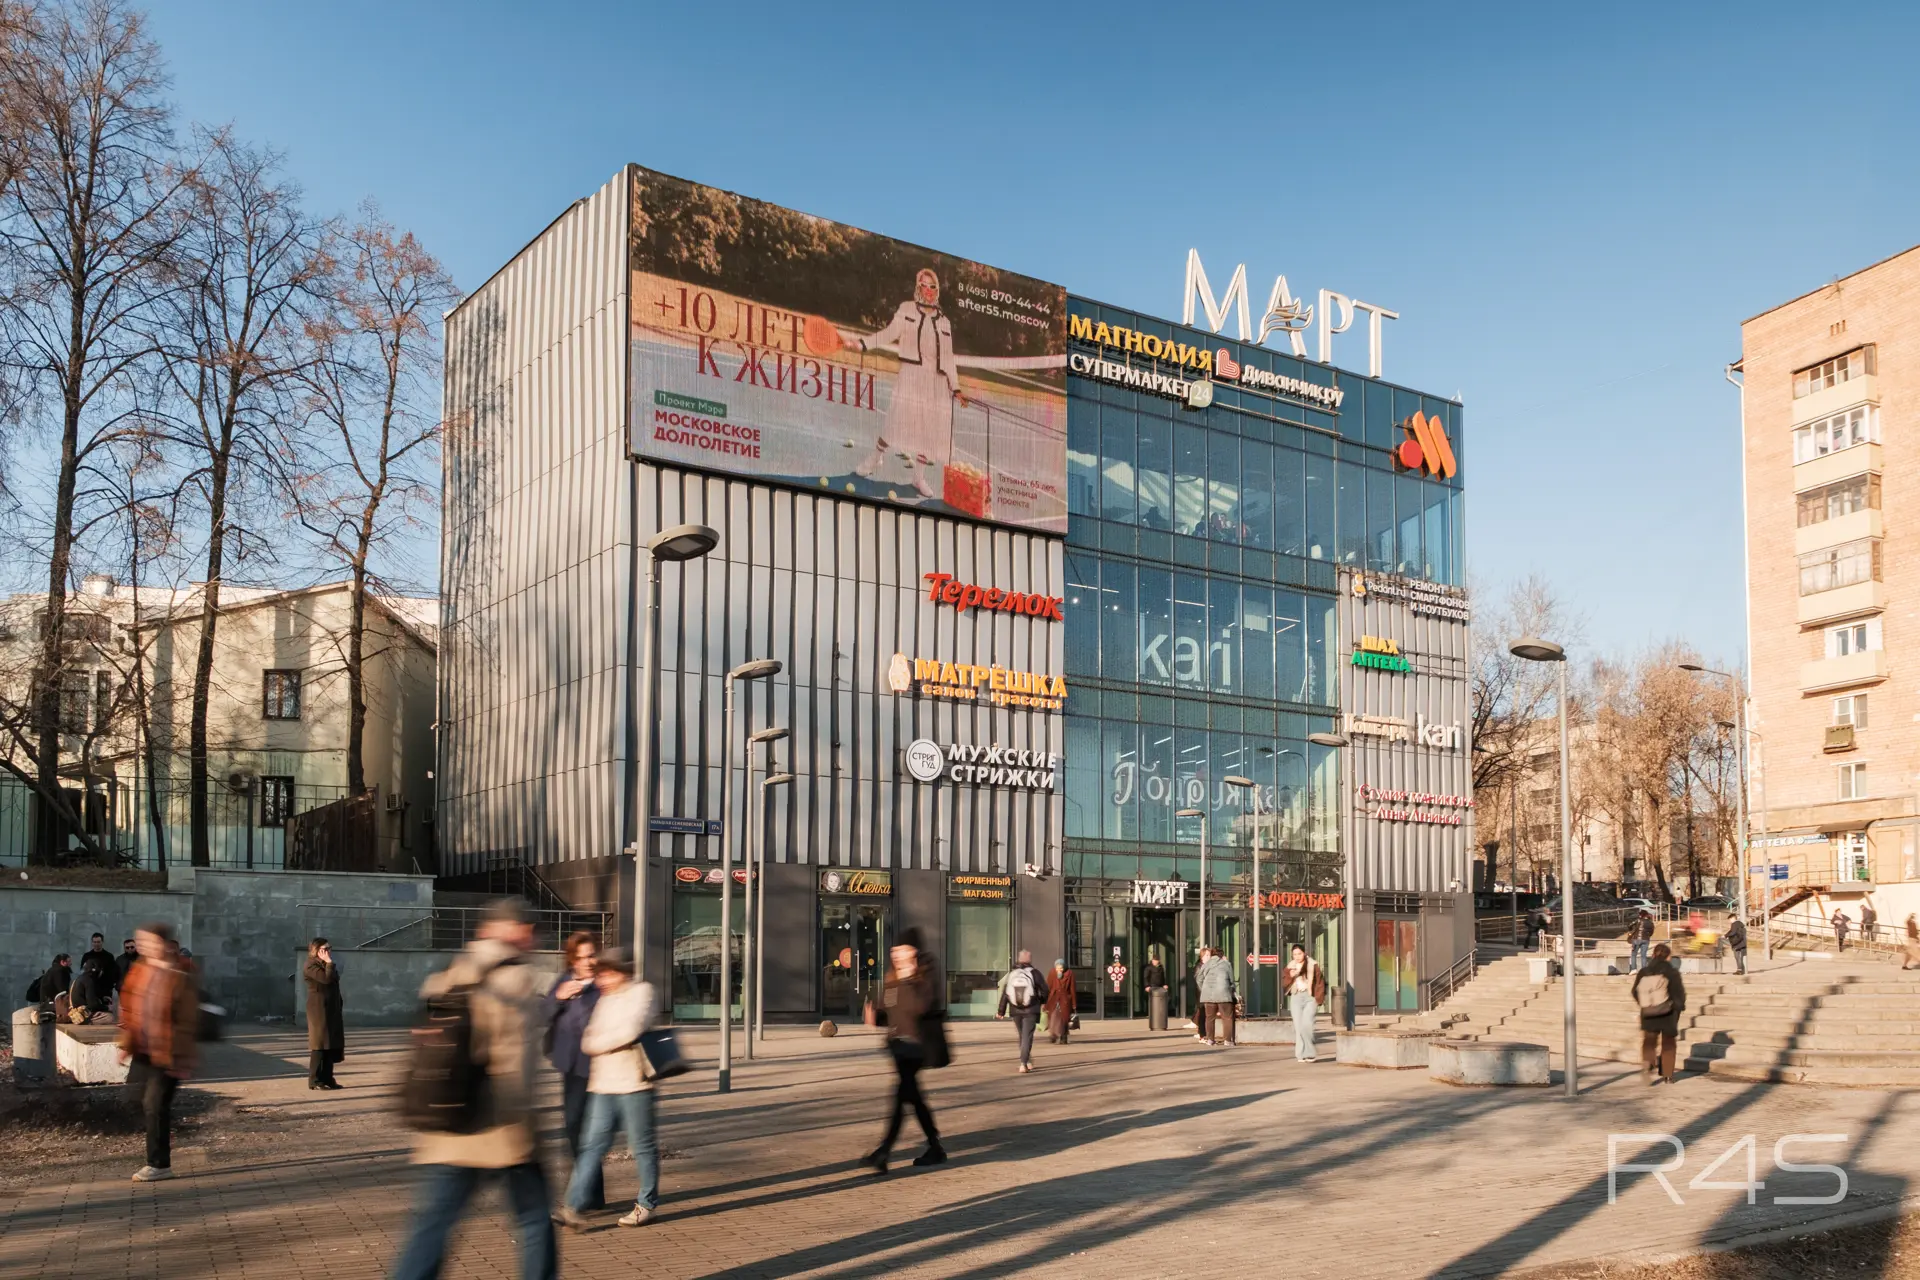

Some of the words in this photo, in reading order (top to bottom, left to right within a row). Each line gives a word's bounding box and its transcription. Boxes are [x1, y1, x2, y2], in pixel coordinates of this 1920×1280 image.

[965, 283, 988, 299] (495)
[990, 290, 1051, 314] 870-44-44
[653, 287, 717, 333] +10
[729, 300, 807, 353] ЛЕТ
[958, 298, 1050, 330] after55.moscow
[1182, 248, 1400, 378] МАРТ
[1070, 314, 1212, 371] МАГНОЛИЯ
[696, 335, 723, 379] К
[733, 344, 877, 412] ЖИЗНИ
[1070, 353, 1191, 398] СУПЕРМАРКЕТ
[1193, 385, 1210, 402] 24
[1242, 364, 1344, 407] Диванчик.ру
[659, 393, 695, 409] Проект
[698, 401, 724, 416] Мэра
[655, 410, 760, 441] МОСКОВСКОЕ
[654, 427, 760, 458] ДОЛГОЛЕТИЕ
[998, 486, 1037, 500] участница
[1030, 481, 1039, 489] 65
[998, 497, 1029, 508] проекта
[924, 573, 1064, 621] Теремок
[1410, 580, 1446, 594] РЕМОНТ
[1410, 591, 1470, 609] СМАРТФОНОВ
[1410, 601, 1418, 611] И
[1419, 603, 1469, 620] НОУТБУКОВ
[1361, 635, 1399, 655] ШАХ
[1140, 629, 1231, 686] kari
[1351, 651, 1411, 673] АПТЕКА
[914, 658, 1068, 697] МАТРЁШКА
[922, 684, 976, 700] салон
[991, 691, 1063, 709] красоты
[1417, 713, 1461, 749] kari
[912, 752, 936, 761] СТРИГ
[921, 760, 936, 770] ГУД
[948, 743, 1057, 769] МУЖСКИЕ
[950, 766, 1055, 789] СТРИЖКИ
[849, 871, 892, 895] Алёнка
[956, 876, 1011, 886] ФИРМЕННЫЙ
[963, 889, 1003, 899] МАГАЗИН
[1134, 884, 1188, 904] МАРТ
[1269, 891, 1345, 909] ФОРАБАНК
